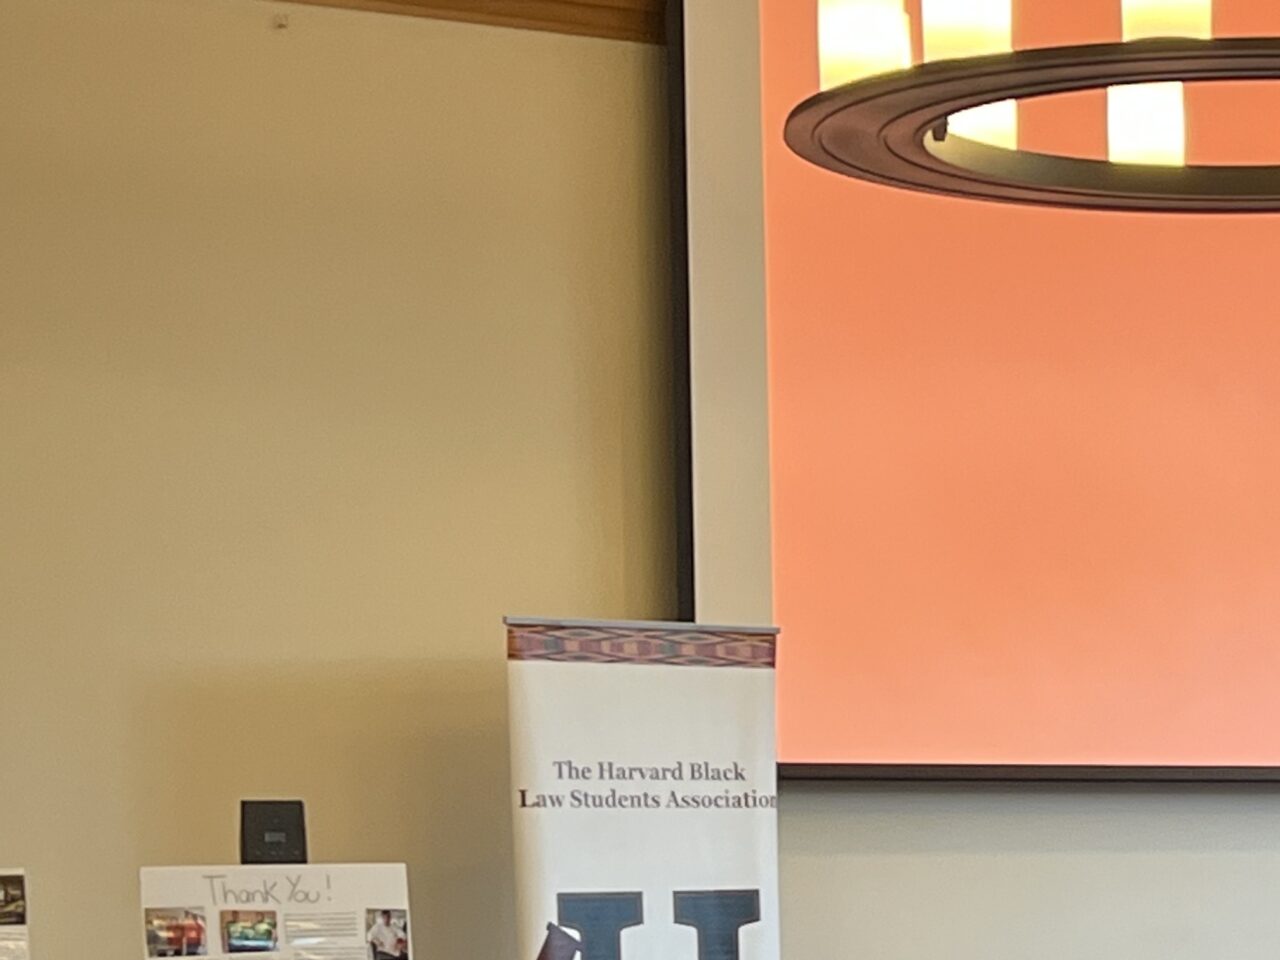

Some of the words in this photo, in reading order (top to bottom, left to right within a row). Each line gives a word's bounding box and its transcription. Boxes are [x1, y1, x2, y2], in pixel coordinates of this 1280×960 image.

[552, 760, 592, 780] The
[598, 761, 684, 780] Harvard
[689, 761, 746, 781] Black
[518, 789, 565, 808] Law
[570, 788, 661, 808] Students
[202, 874, 281, 906] Thank
